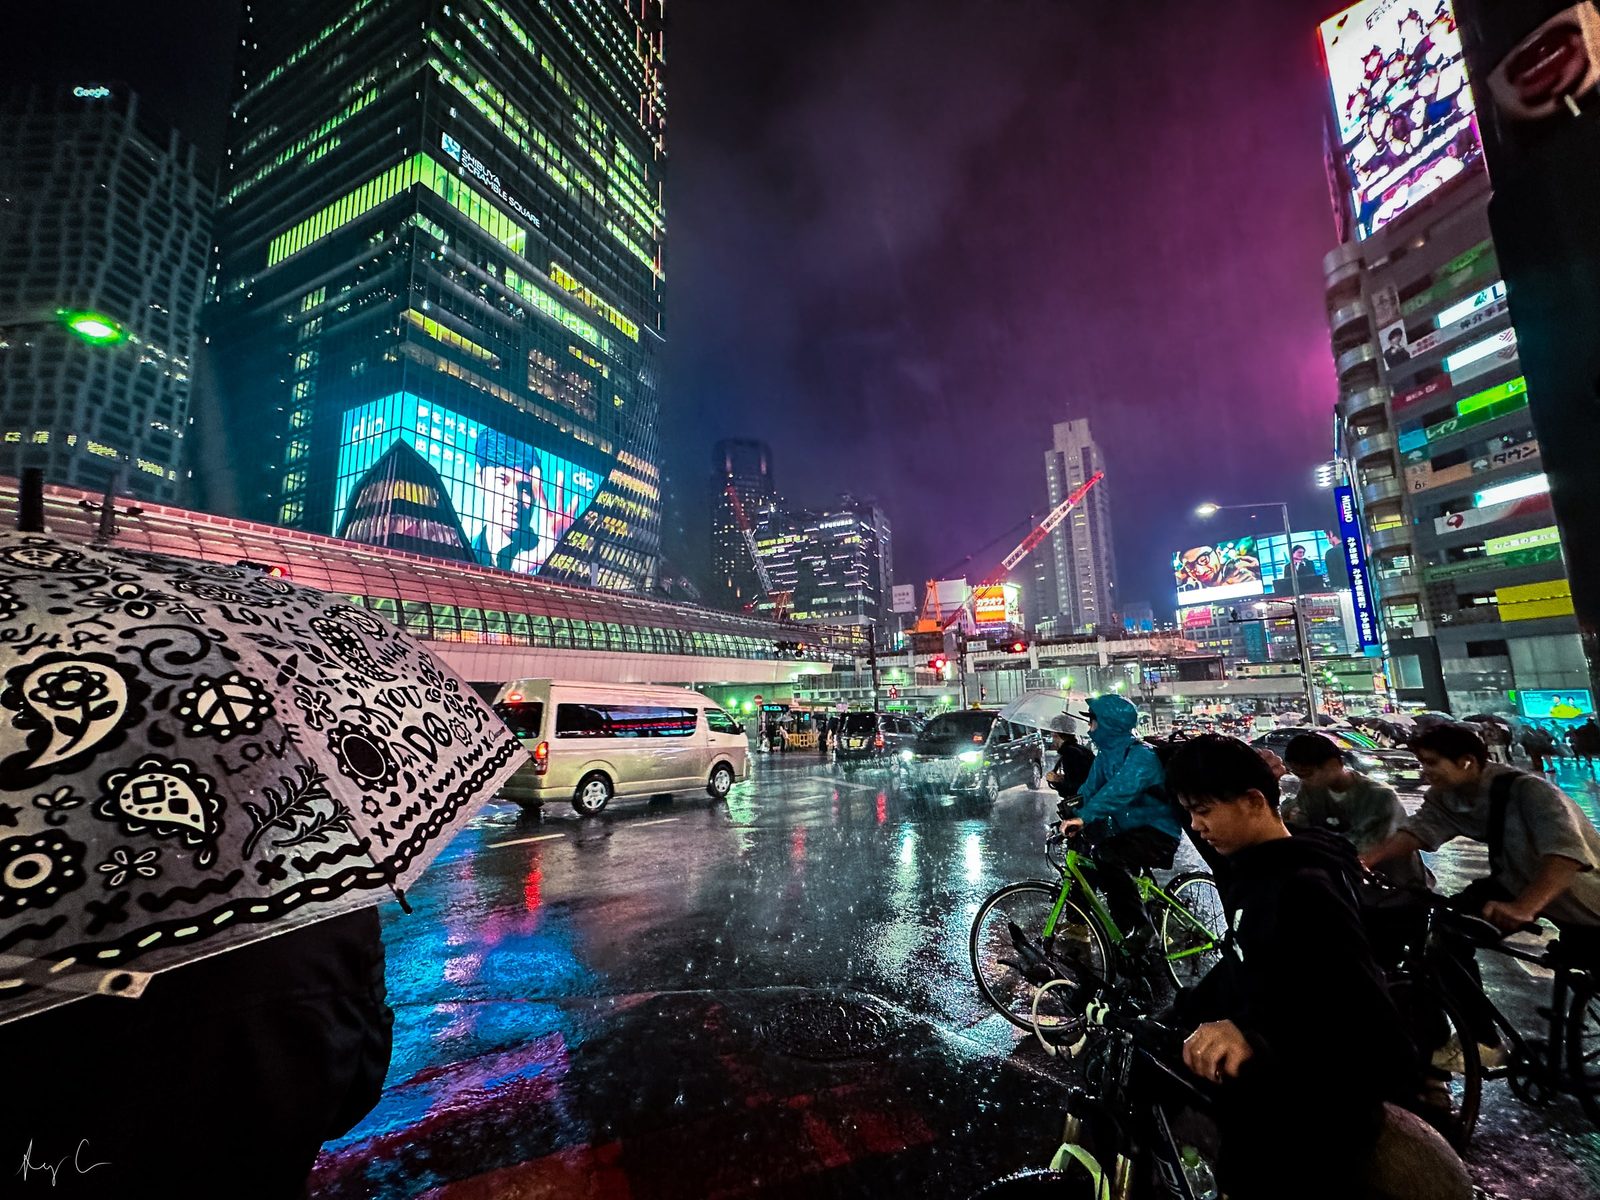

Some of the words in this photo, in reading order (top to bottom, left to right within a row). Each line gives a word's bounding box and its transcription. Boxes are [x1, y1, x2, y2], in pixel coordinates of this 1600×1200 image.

[73, 86, 110, 98] Google
[462, 149, 501, 187] SHIBUYA
[462, 158, 508, 202] SCRAMBLE
[508, 196, 541, 229] SQUARE
[1493, 446, 1537, 464] タウン
[1341, 494, 1354, 524] MIZUHO
[213, 604, 312, 640] LOVE
[376, 631, 415, 669] WHAT
[374, 684, 423, 722] YOU
[213, 722, 304, 776] LOVE
